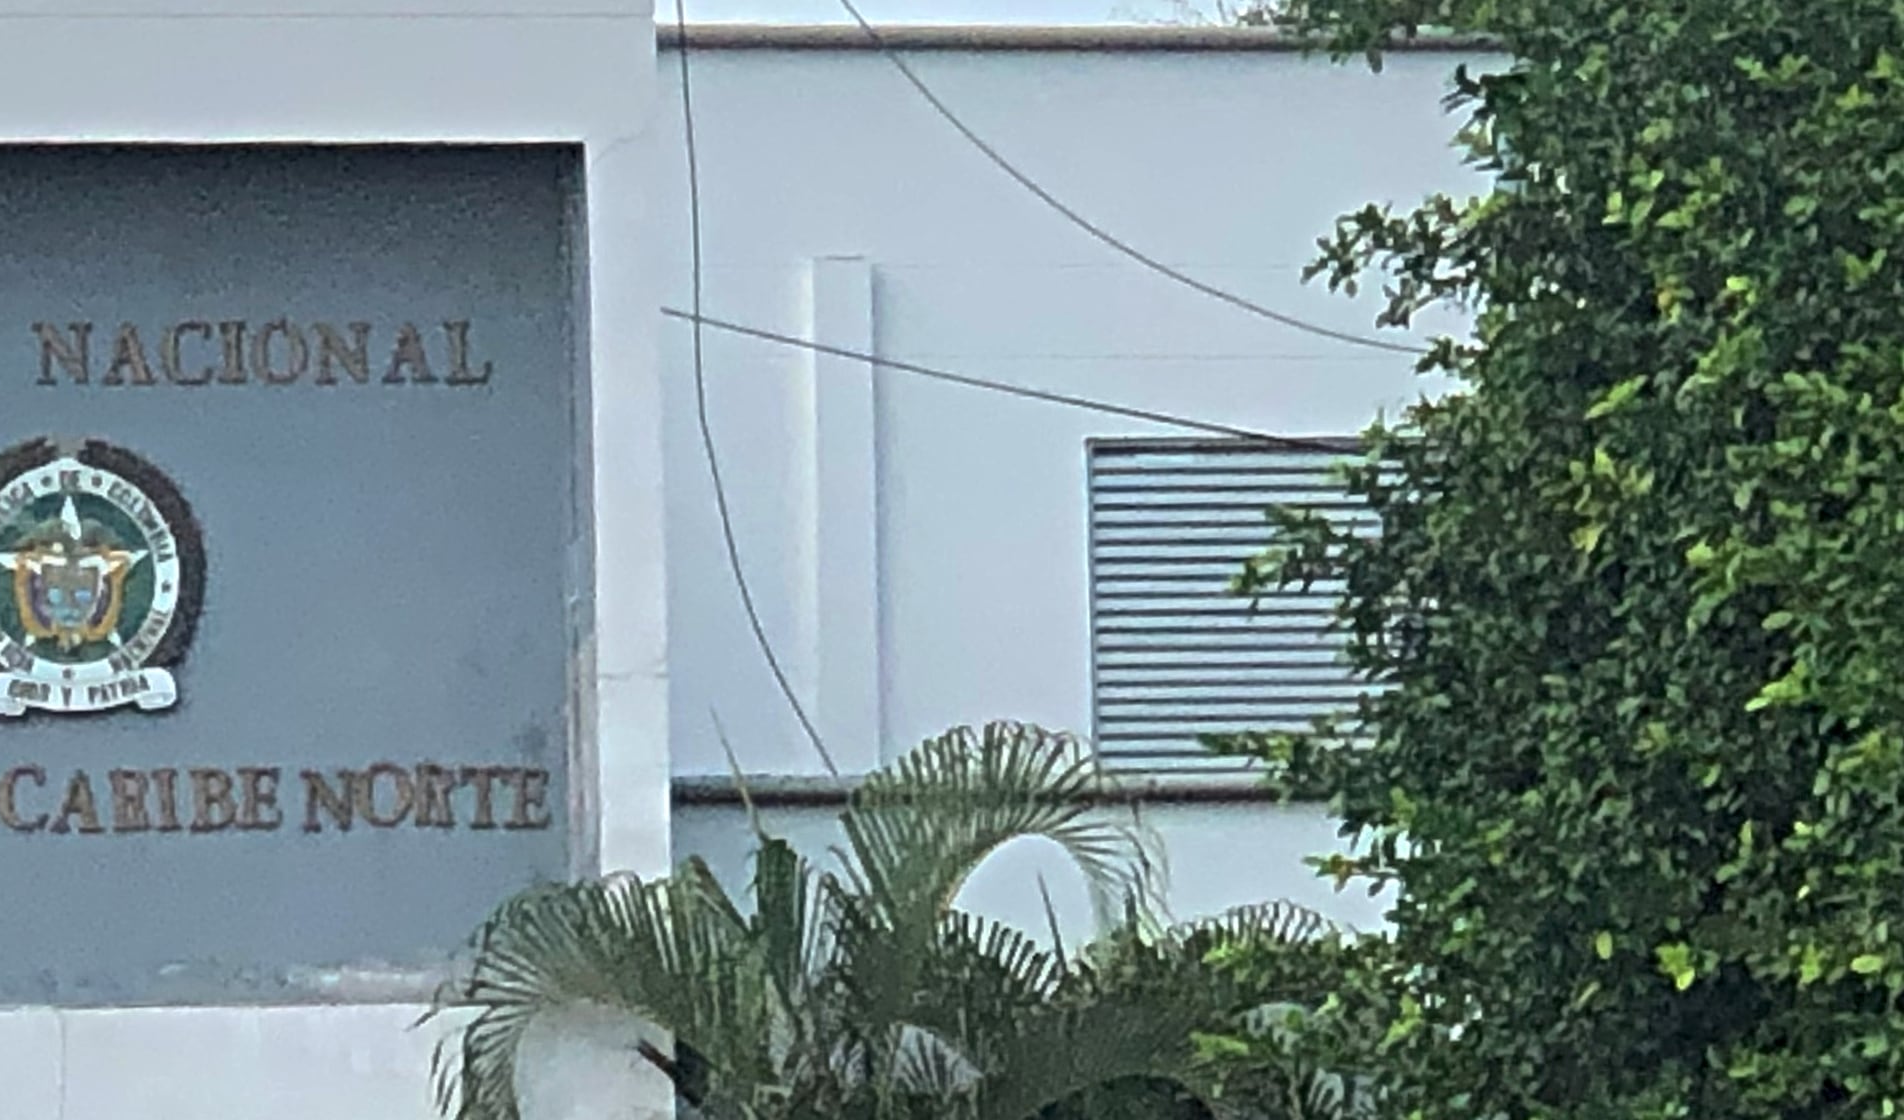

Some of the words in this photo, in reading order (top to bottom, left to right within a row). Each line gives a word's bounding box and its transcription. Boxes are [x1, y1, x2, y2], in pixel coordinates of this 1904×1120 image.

[31, 316, 493, 387] NACIONAL
[61, 685, 73, 707] Y
[300, 760, 551, 833] NORTE
